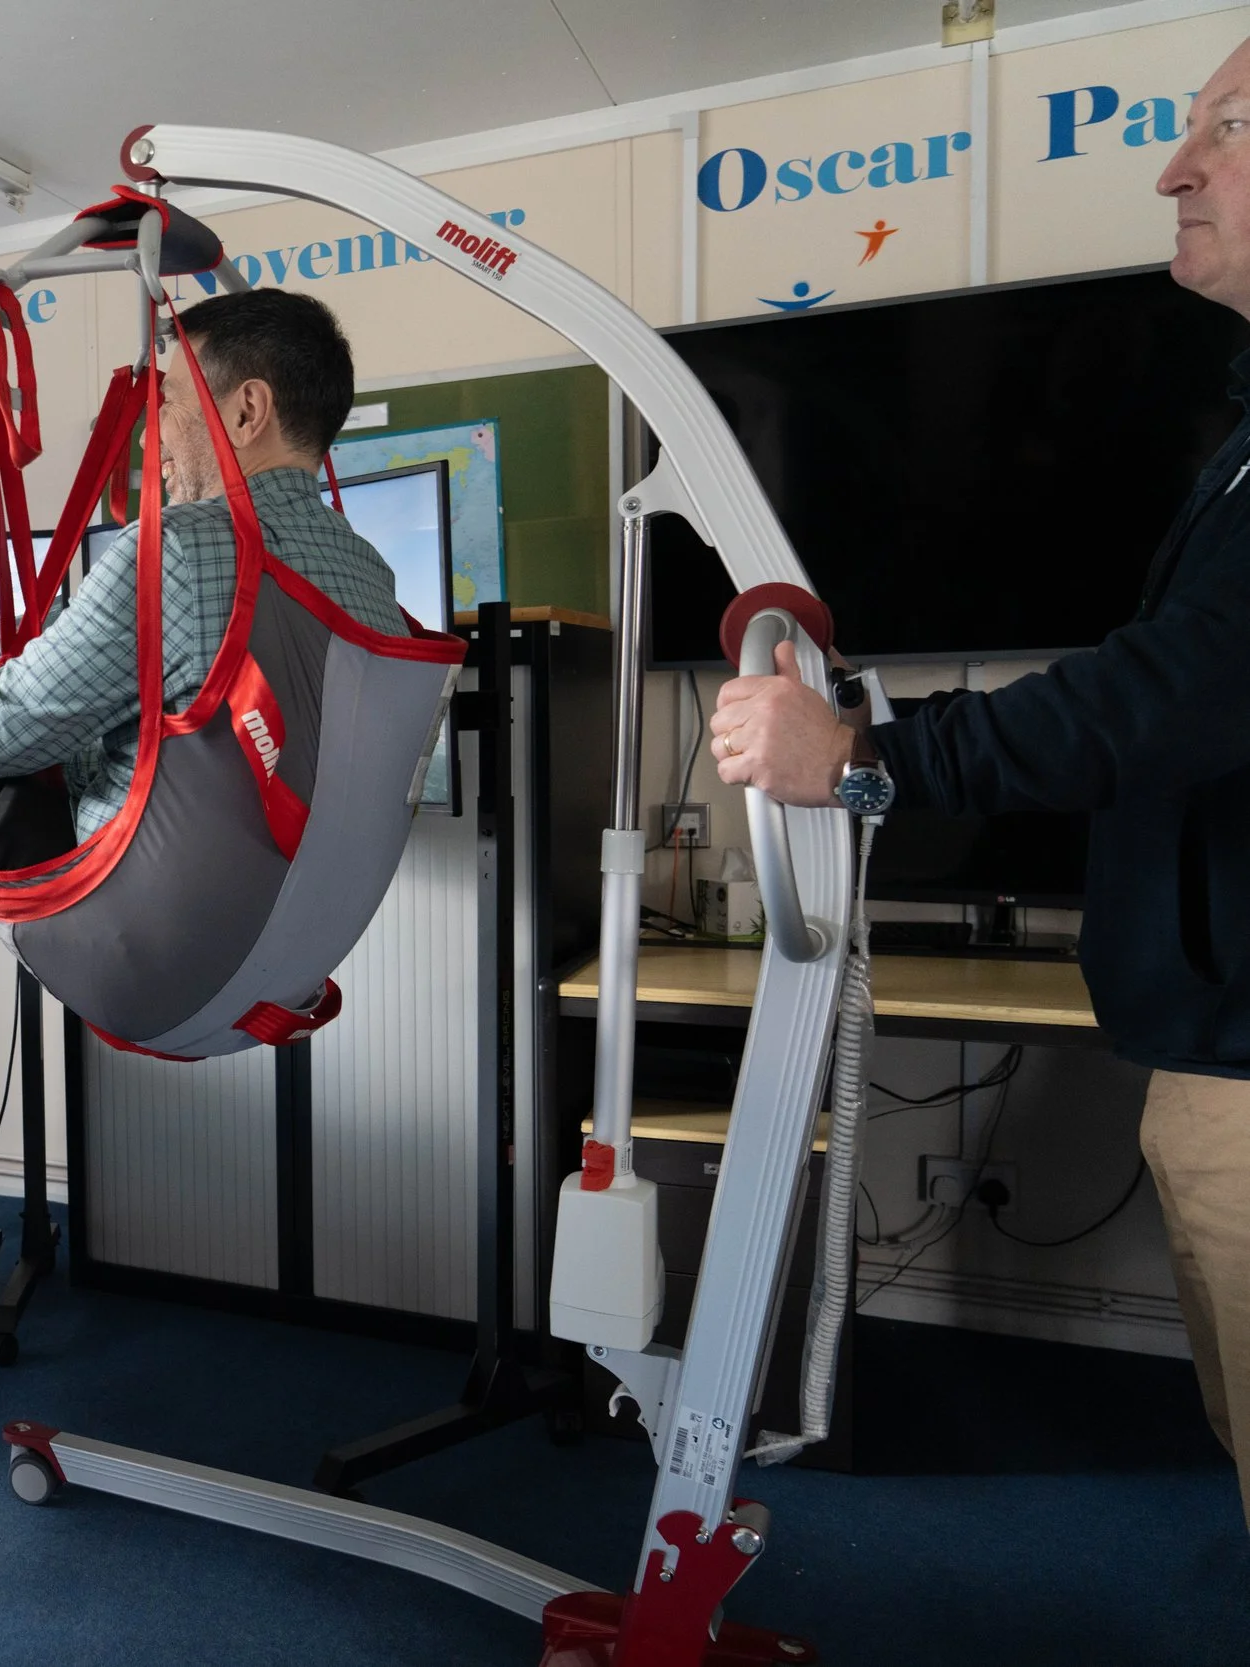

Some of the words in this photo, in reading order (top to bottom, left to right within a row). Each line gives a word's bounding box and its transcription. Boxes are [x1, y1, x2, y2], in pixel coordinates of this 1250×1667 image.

[1037, 86, 1201, 162] Pa
[696, 130, 972, 212] Oscar
[436, 220, 517, 276] molift
[471, 260, 492, 275] SMART
[492, 271, 503, 281] 150
